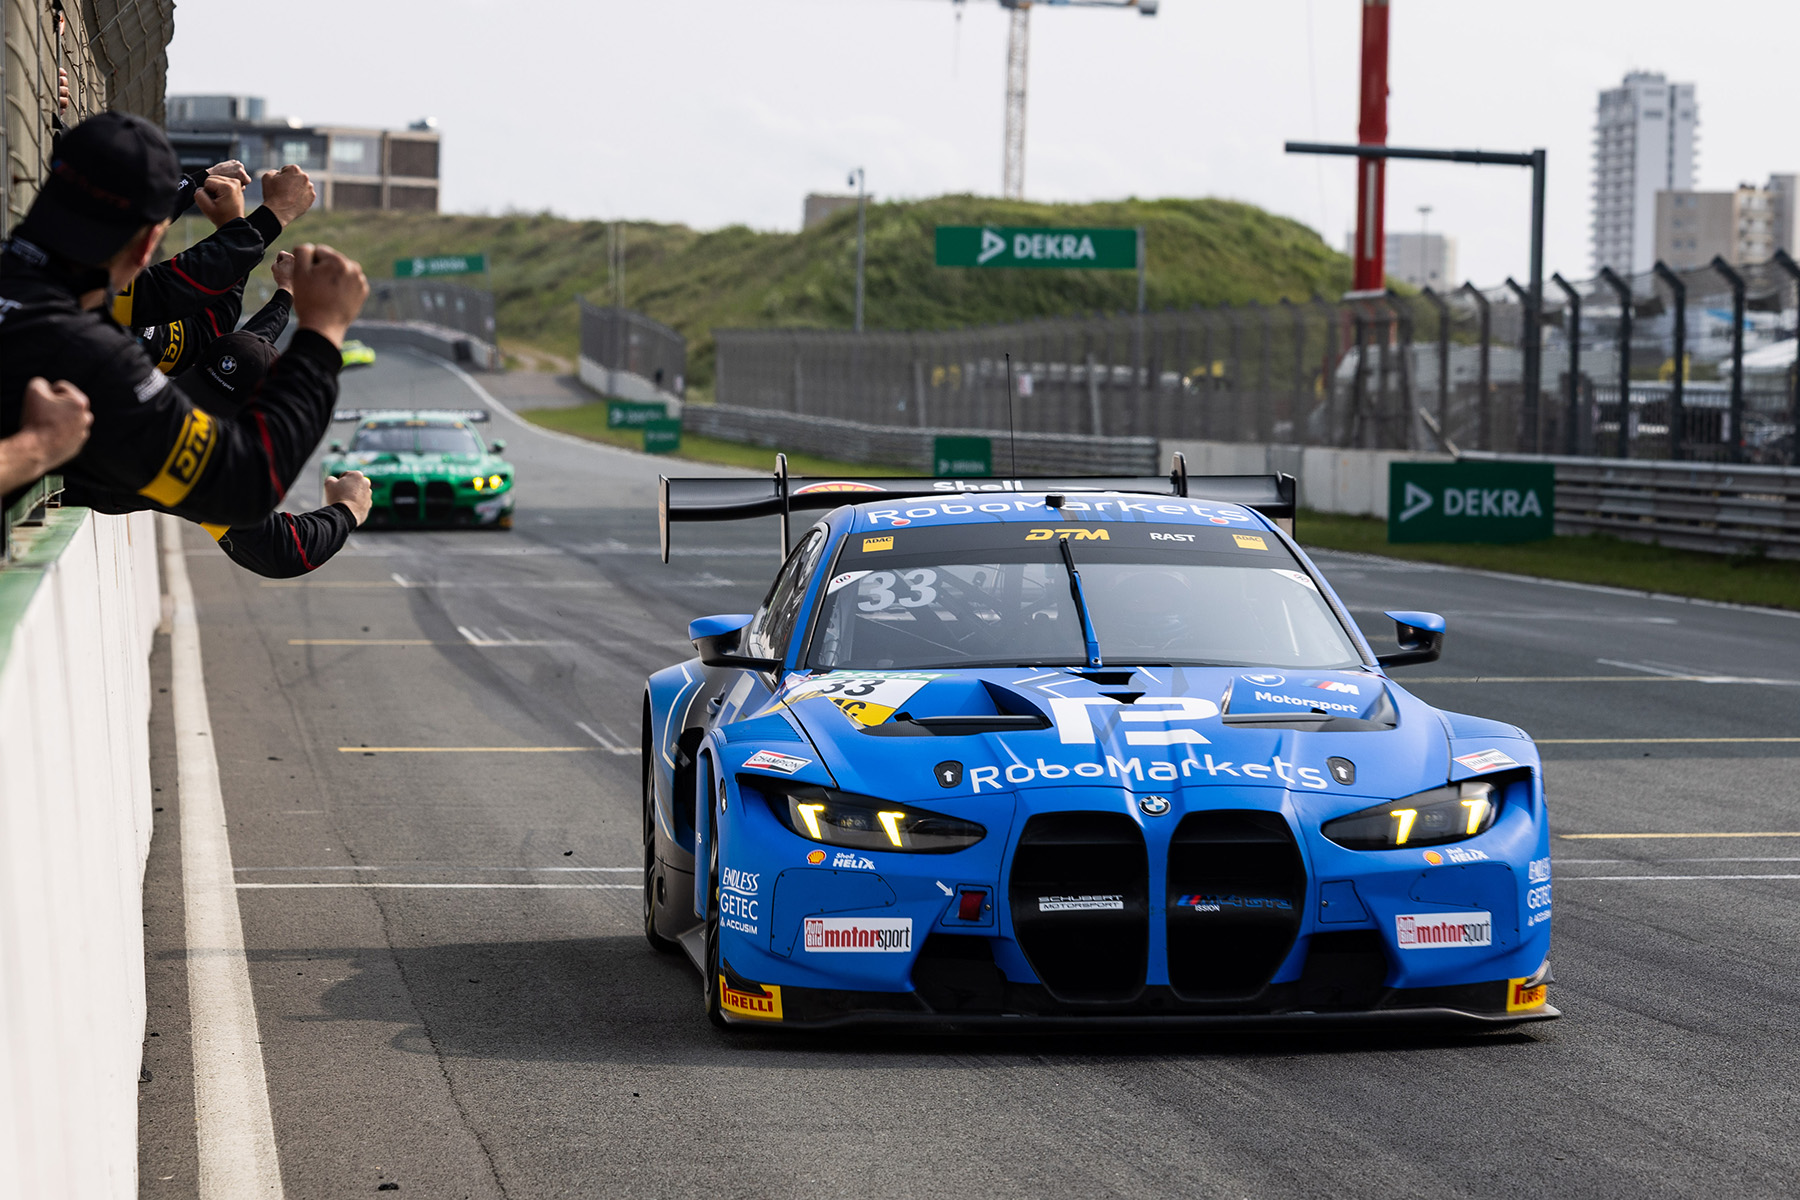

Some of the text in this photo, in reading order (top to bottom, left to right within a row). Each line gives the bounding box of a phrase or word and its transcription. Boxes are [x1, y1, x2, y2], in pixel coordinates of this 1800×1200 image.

[1013, 233, 1096, 260] DEKRA
[175, 408, 211, 479] DTM
[932, 480, 1024, 492] Shell
[1443, 487, 1542, 518] DEKRA
[867, 500, 1250, 525] RoboMarkets
[865, 536, 893, 545] ADAC
[1025, 528, 1110, 541] DTM
[1150, 532, 1196, 542] RAST
[1235, 534, 1262, 543] ADAC
[857, 568, 938, 612] 33
[821, 679, 886, 697] 33
[1254, 690, 1359, 714] Motorsport
[753, 755, 800, 769] CHAMPION
[970, 754, 1329, 794] RoboMarkets
[832, 856, 876, 871] HELIX
[836, 852, 855, 860] Shell
[1449, 848, 1490, 864] HELIX
[722, 867, 760, 893] ENDLESS
[720, 893, 759, 921] GETEC
[1038, 894, 1123, 902] SCHUBERT
[1043, 901, 1120, 910] MOTORSPORT
[726, 918, 758, 935] ACCUSIM
[1416, 920, 1491, 946] motorsport
[825, 926, 911, 951] motorsport
[722, 982, 773, 1013] PIRELLI
